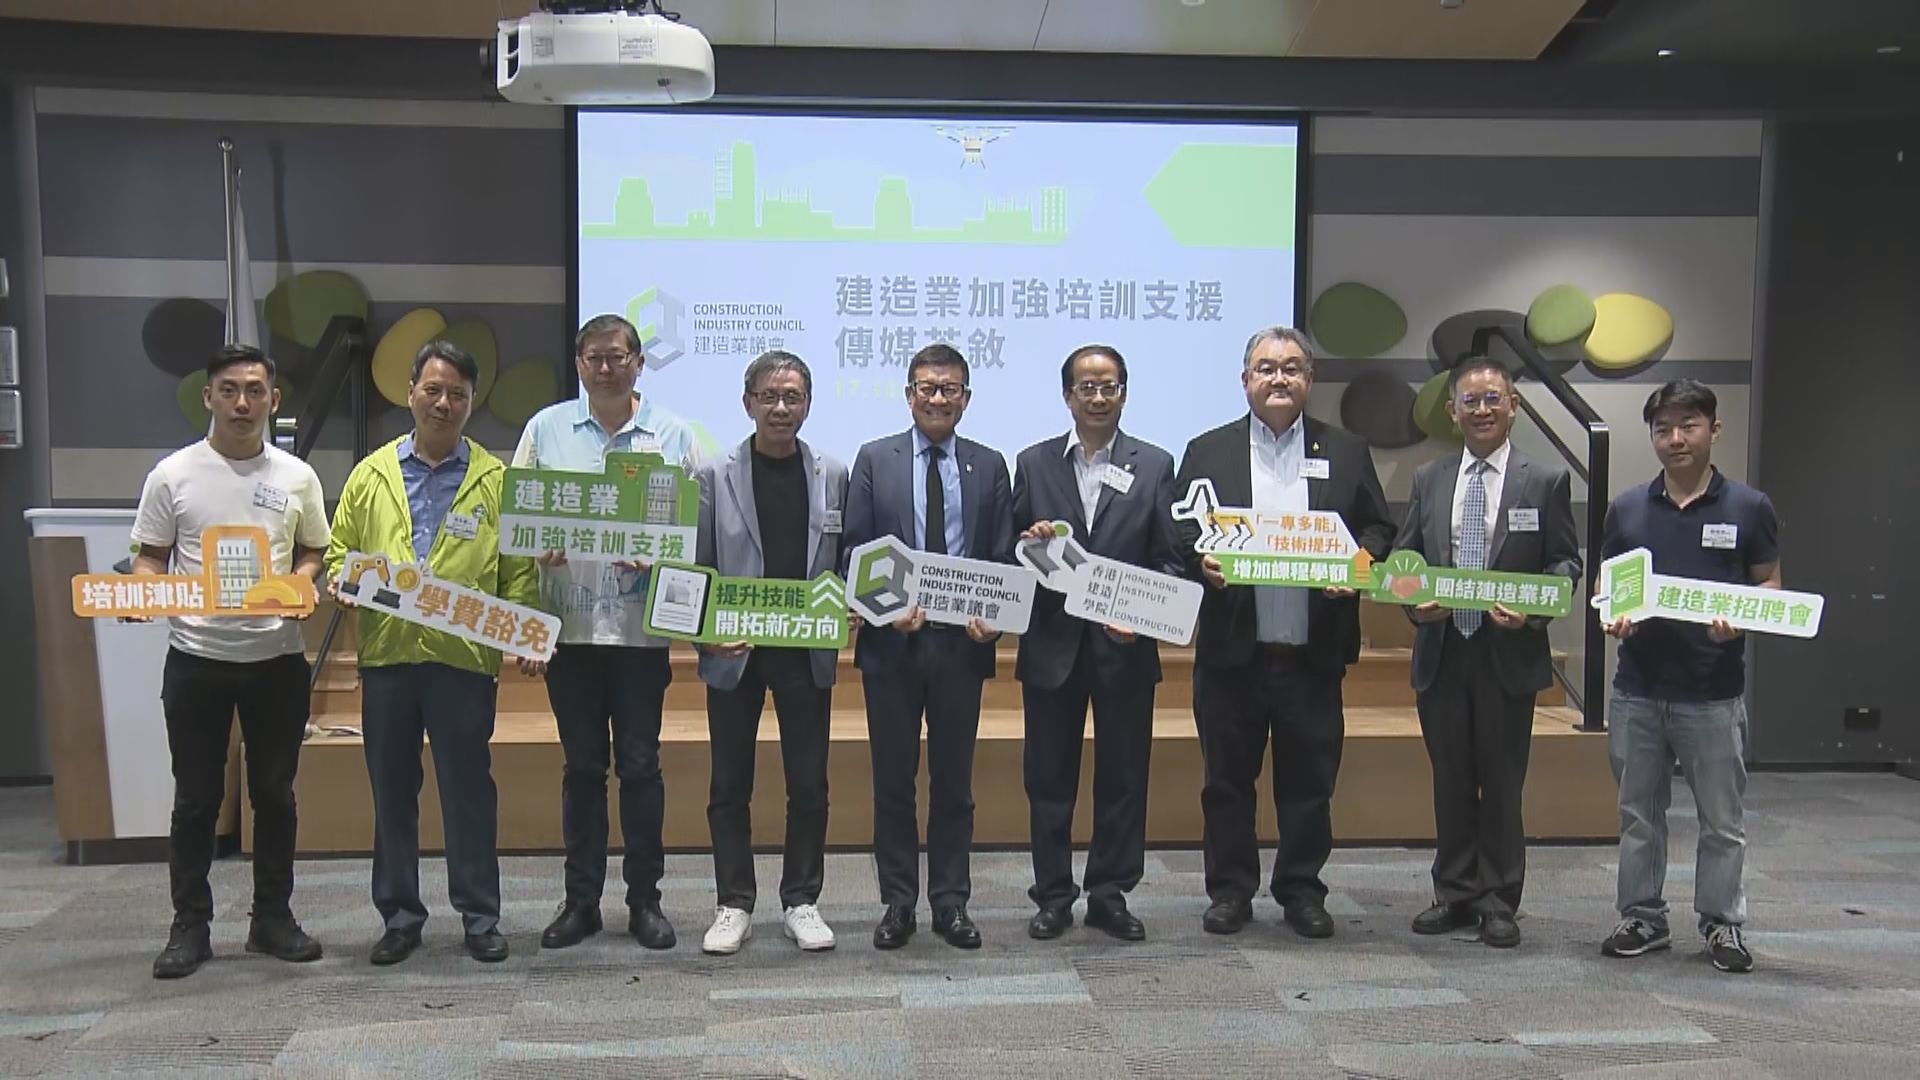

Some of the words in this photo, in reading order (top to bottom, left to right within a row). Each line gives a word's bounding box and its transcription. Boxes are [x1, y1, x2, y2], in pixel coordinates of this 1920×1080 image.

[693, 304, 783, 315] CONSTRUCTION
[835, 274, 1223, 322] 建造業加強培訓支援
[694, 320, 751, 331] INDUSTRY
[754, 320, 805, 331] COUNCIL
[515, 479, 620, 516] 建造業
[1256, 513, 1337, 534] 「一專多能」
[511, 523, 684, 559] 加強培訓支援
[1266, 535, 1348, 555] 「技術提升」
[921, 565, 1003, 586] CONSTRUCTION
[1092, 565, 1117, 582] 香港
[1124, 572, 1151, 586] HONG
[1152, 580, 1179, 594] KONG
[1233, 558, 1348, 583] 增加課程學額
[82, 580, 204, 610] 培訓津貼
[716, 583, 806, 609] 提升技能
[919, 578, 973, 595] INDUSTRY
[975, 585, 1022, 603] COUNCIL
[1087, 582, 1113, 599] 建造
[1117, 598, 1129, 608] OF
[1121, 585, 1168, 604] INSTITUTE
[1434, 576, 1559, 607] 團結建造業界
[414, 583, 551, 654] 學費豁免
[917, 592, 1001, 620] 建造業議會
[1083, 598, 1110, 616] 學院
[1656, 586, 1813, 628] 建造業招聘會
[715, 610, 839, 640] 開拓新方向
[1113, 611, 1185, 637] CONSTRUCTION
